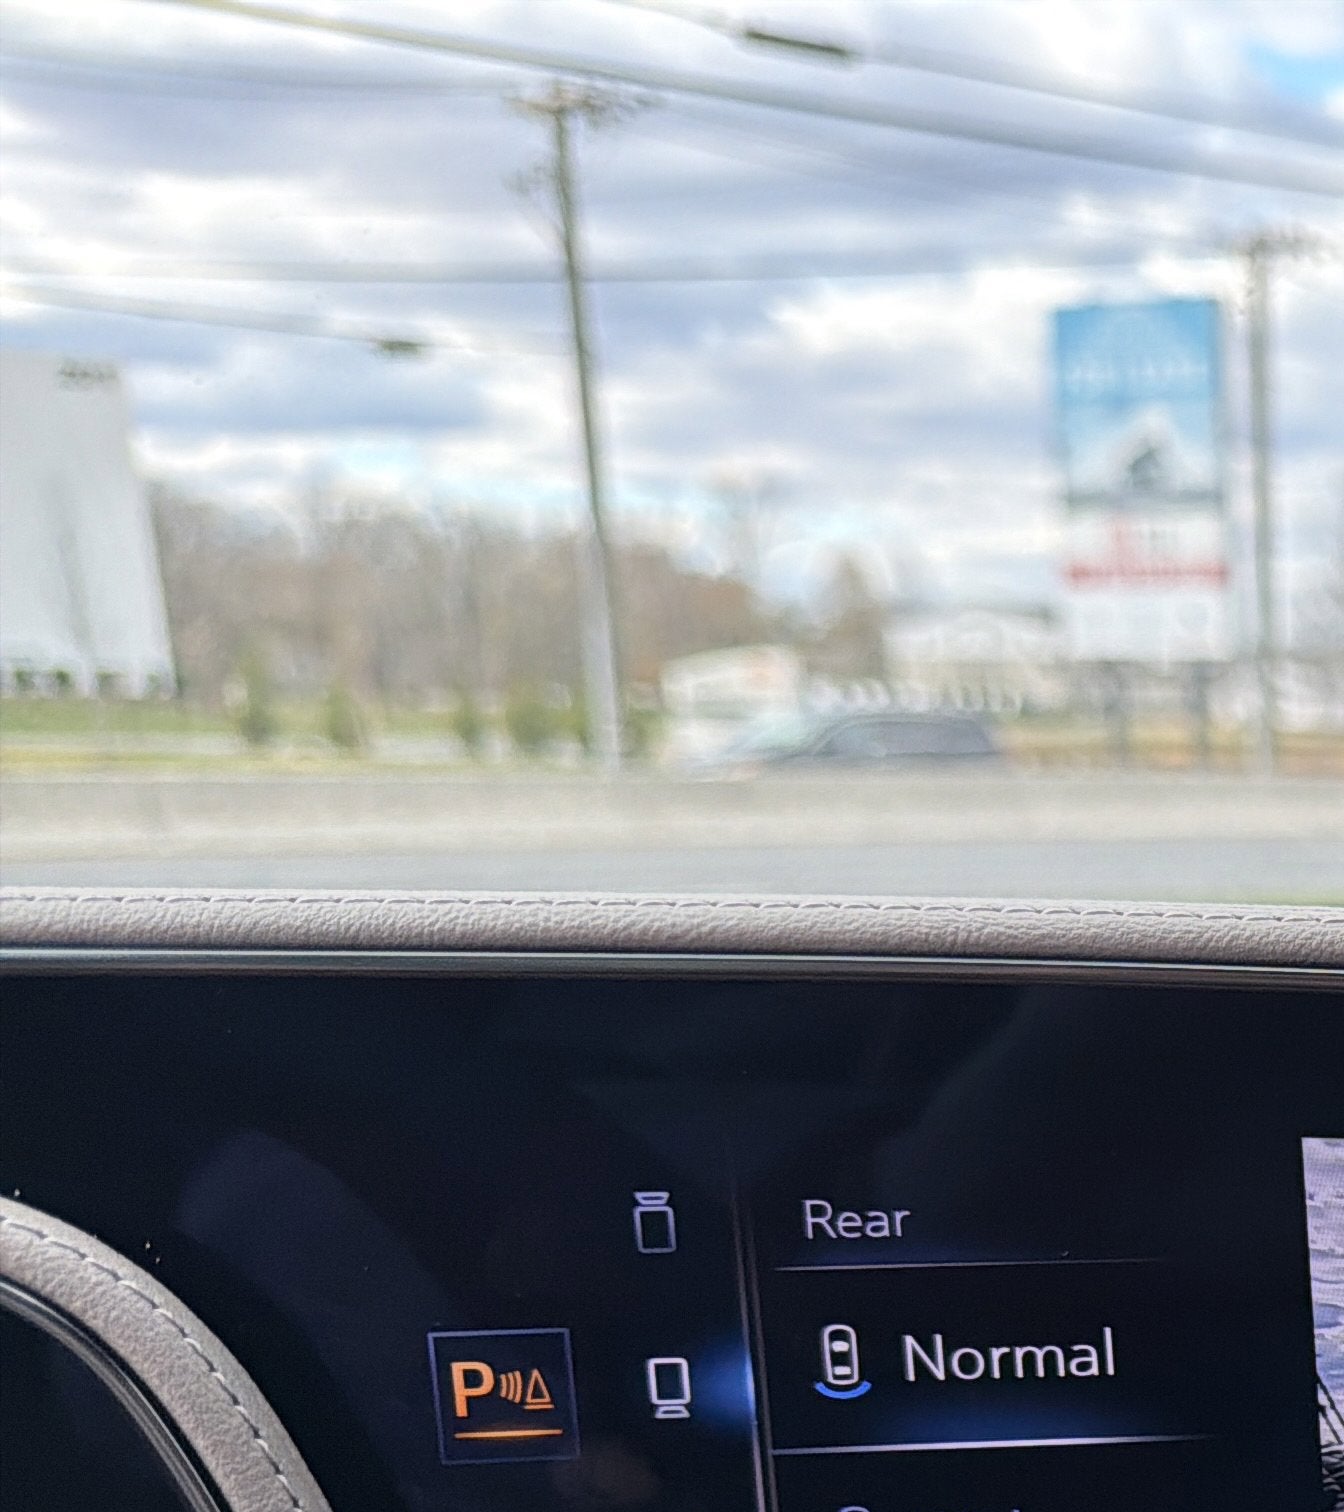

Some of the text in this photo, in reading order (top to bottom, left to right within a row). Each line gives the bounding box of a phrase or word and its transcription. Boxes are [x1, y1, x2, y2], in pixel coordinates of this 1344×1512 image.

[802, 1199, 911, 1240] Rear
[902, 1326, 1116, 1382] Normal
[450, 1360, 495, 1418] P
